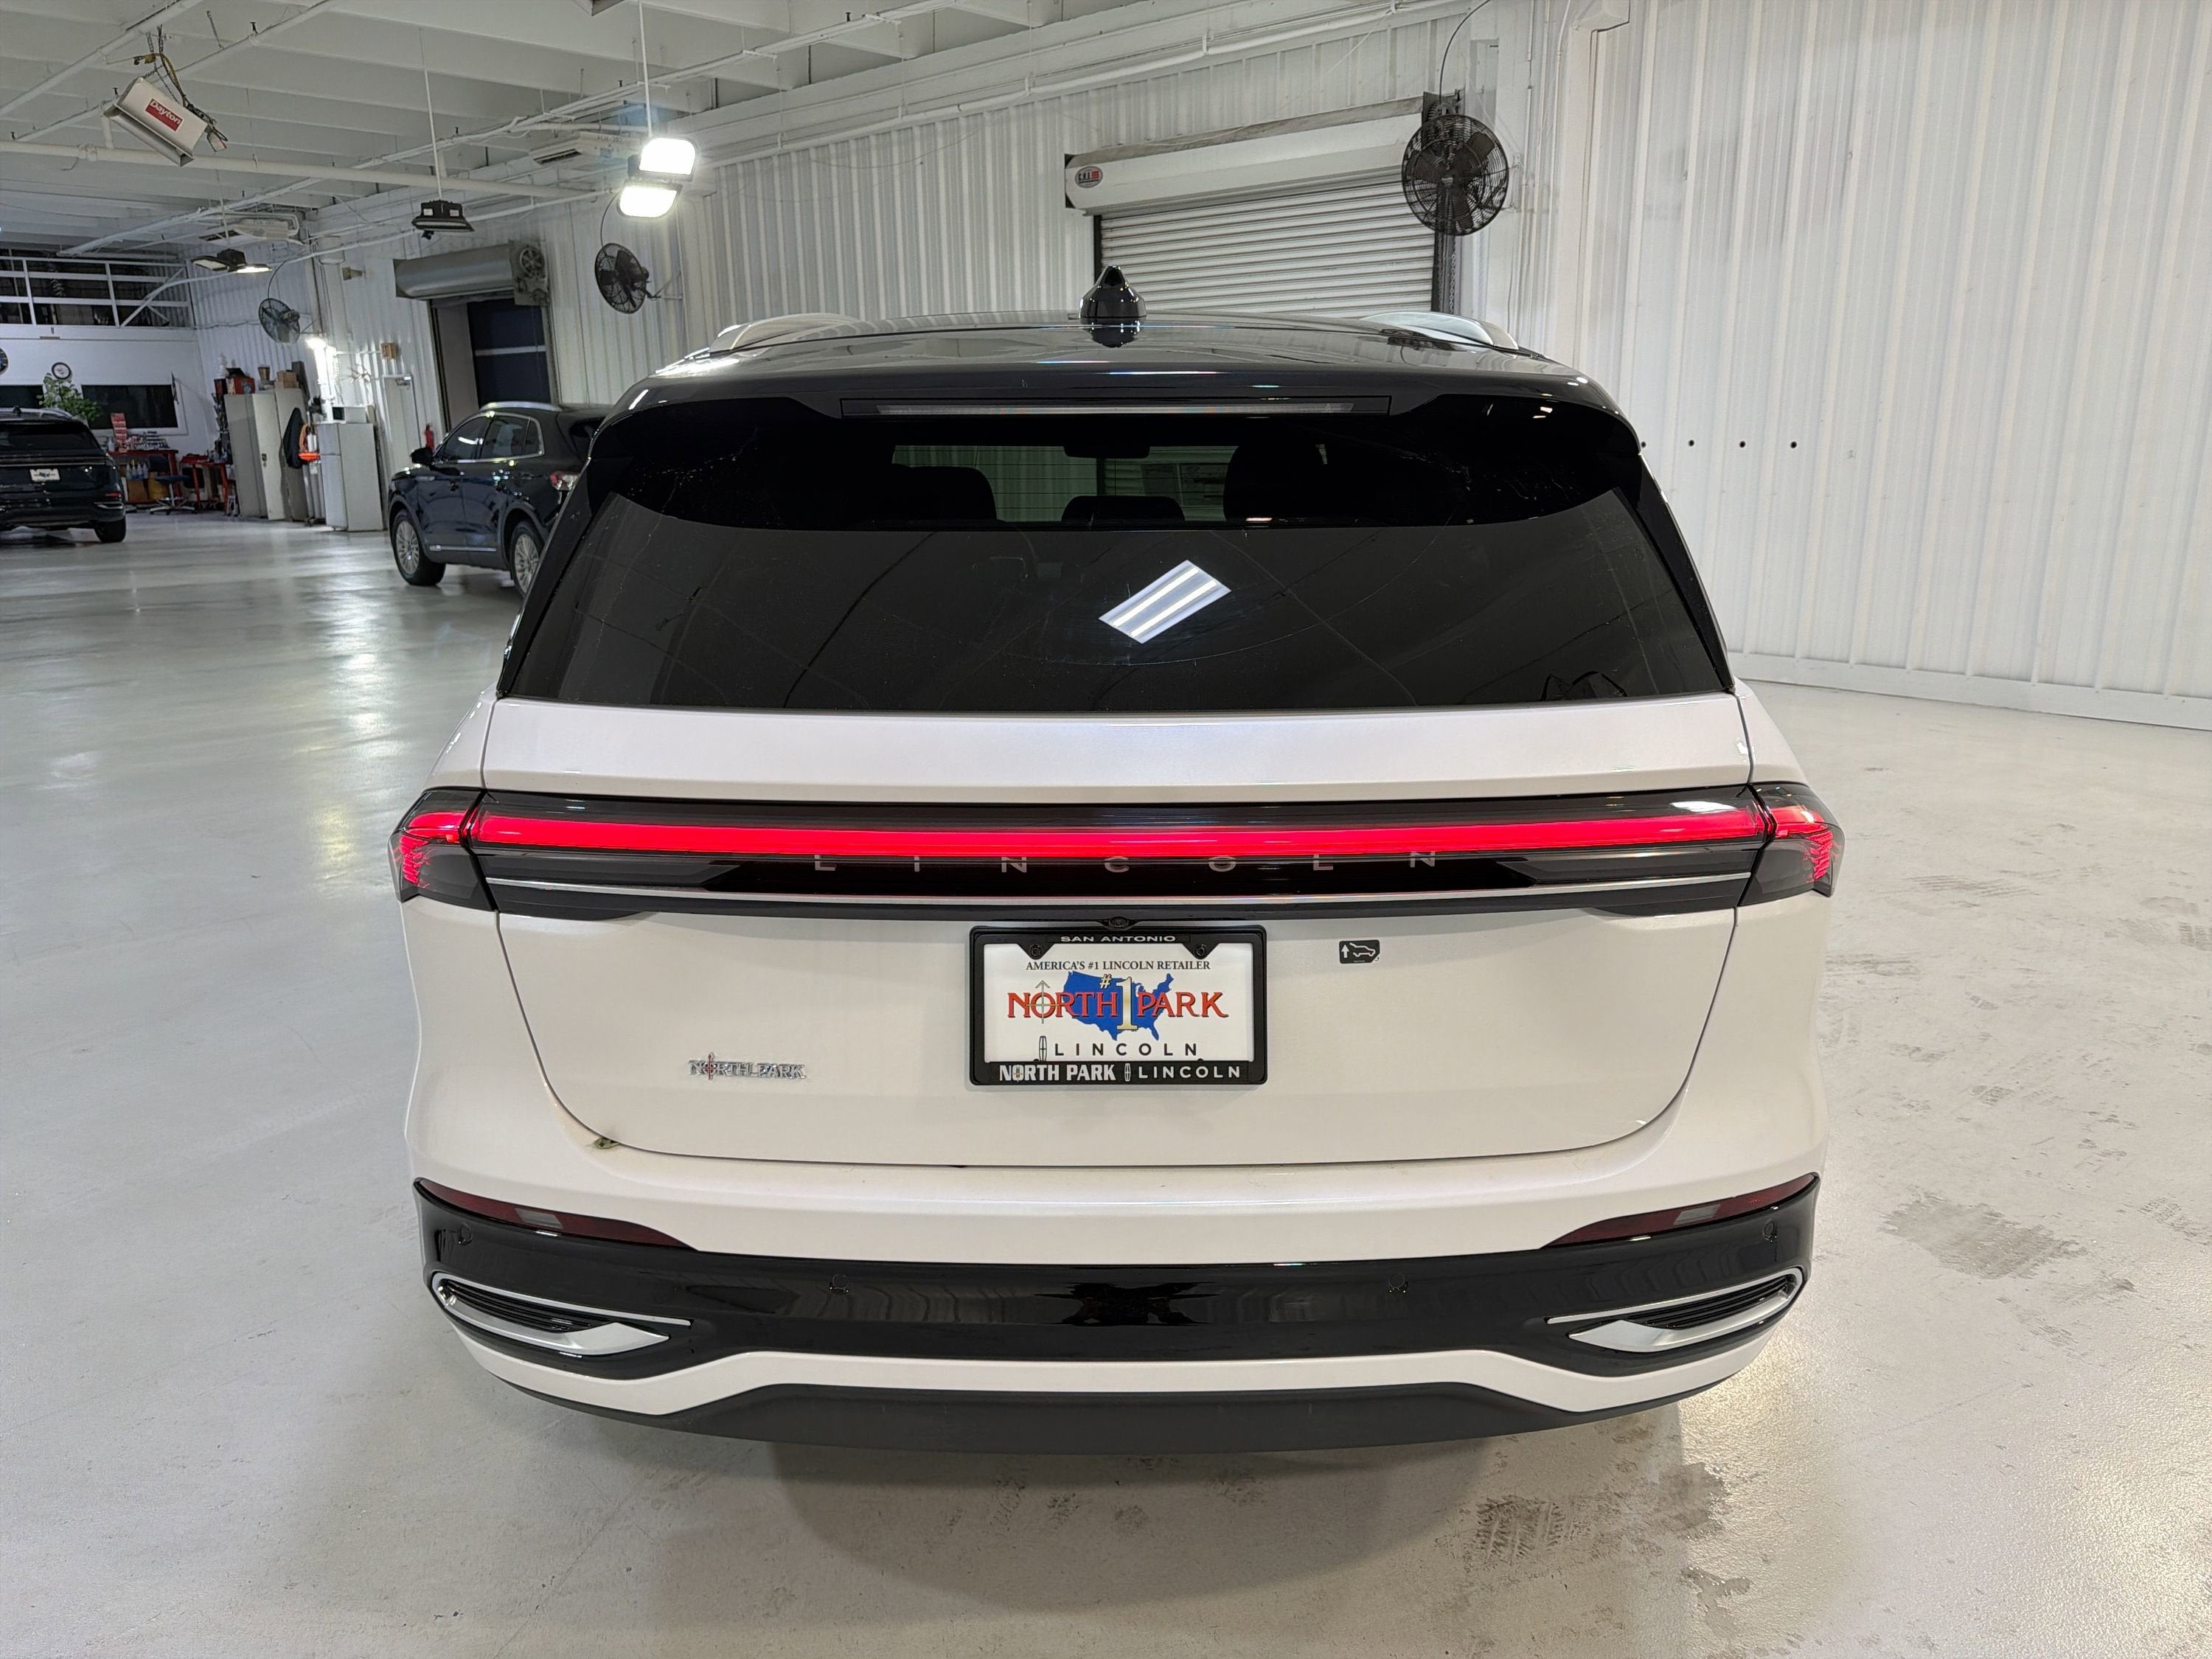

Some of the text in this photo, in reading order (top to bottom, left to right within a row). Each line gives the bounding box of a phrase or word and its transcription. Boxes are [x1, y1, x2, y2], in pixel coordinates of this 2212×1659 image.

[150, 100, 181, 125] Dayton
[814, 851, 1436, 873] LINCOLN
[1026, 961, 1211, 970] AMERICA'S #1 LINCOLN RETAILER
[1007, 992, 1229, 1018] NORTH PARK
[1054, 1043, 1197, 1057] LINCOLN
[688, 1060, 807, 1079] NORTH PARK
[999, 1062, 1240, 1082] NORTH PARK LINCOLN
